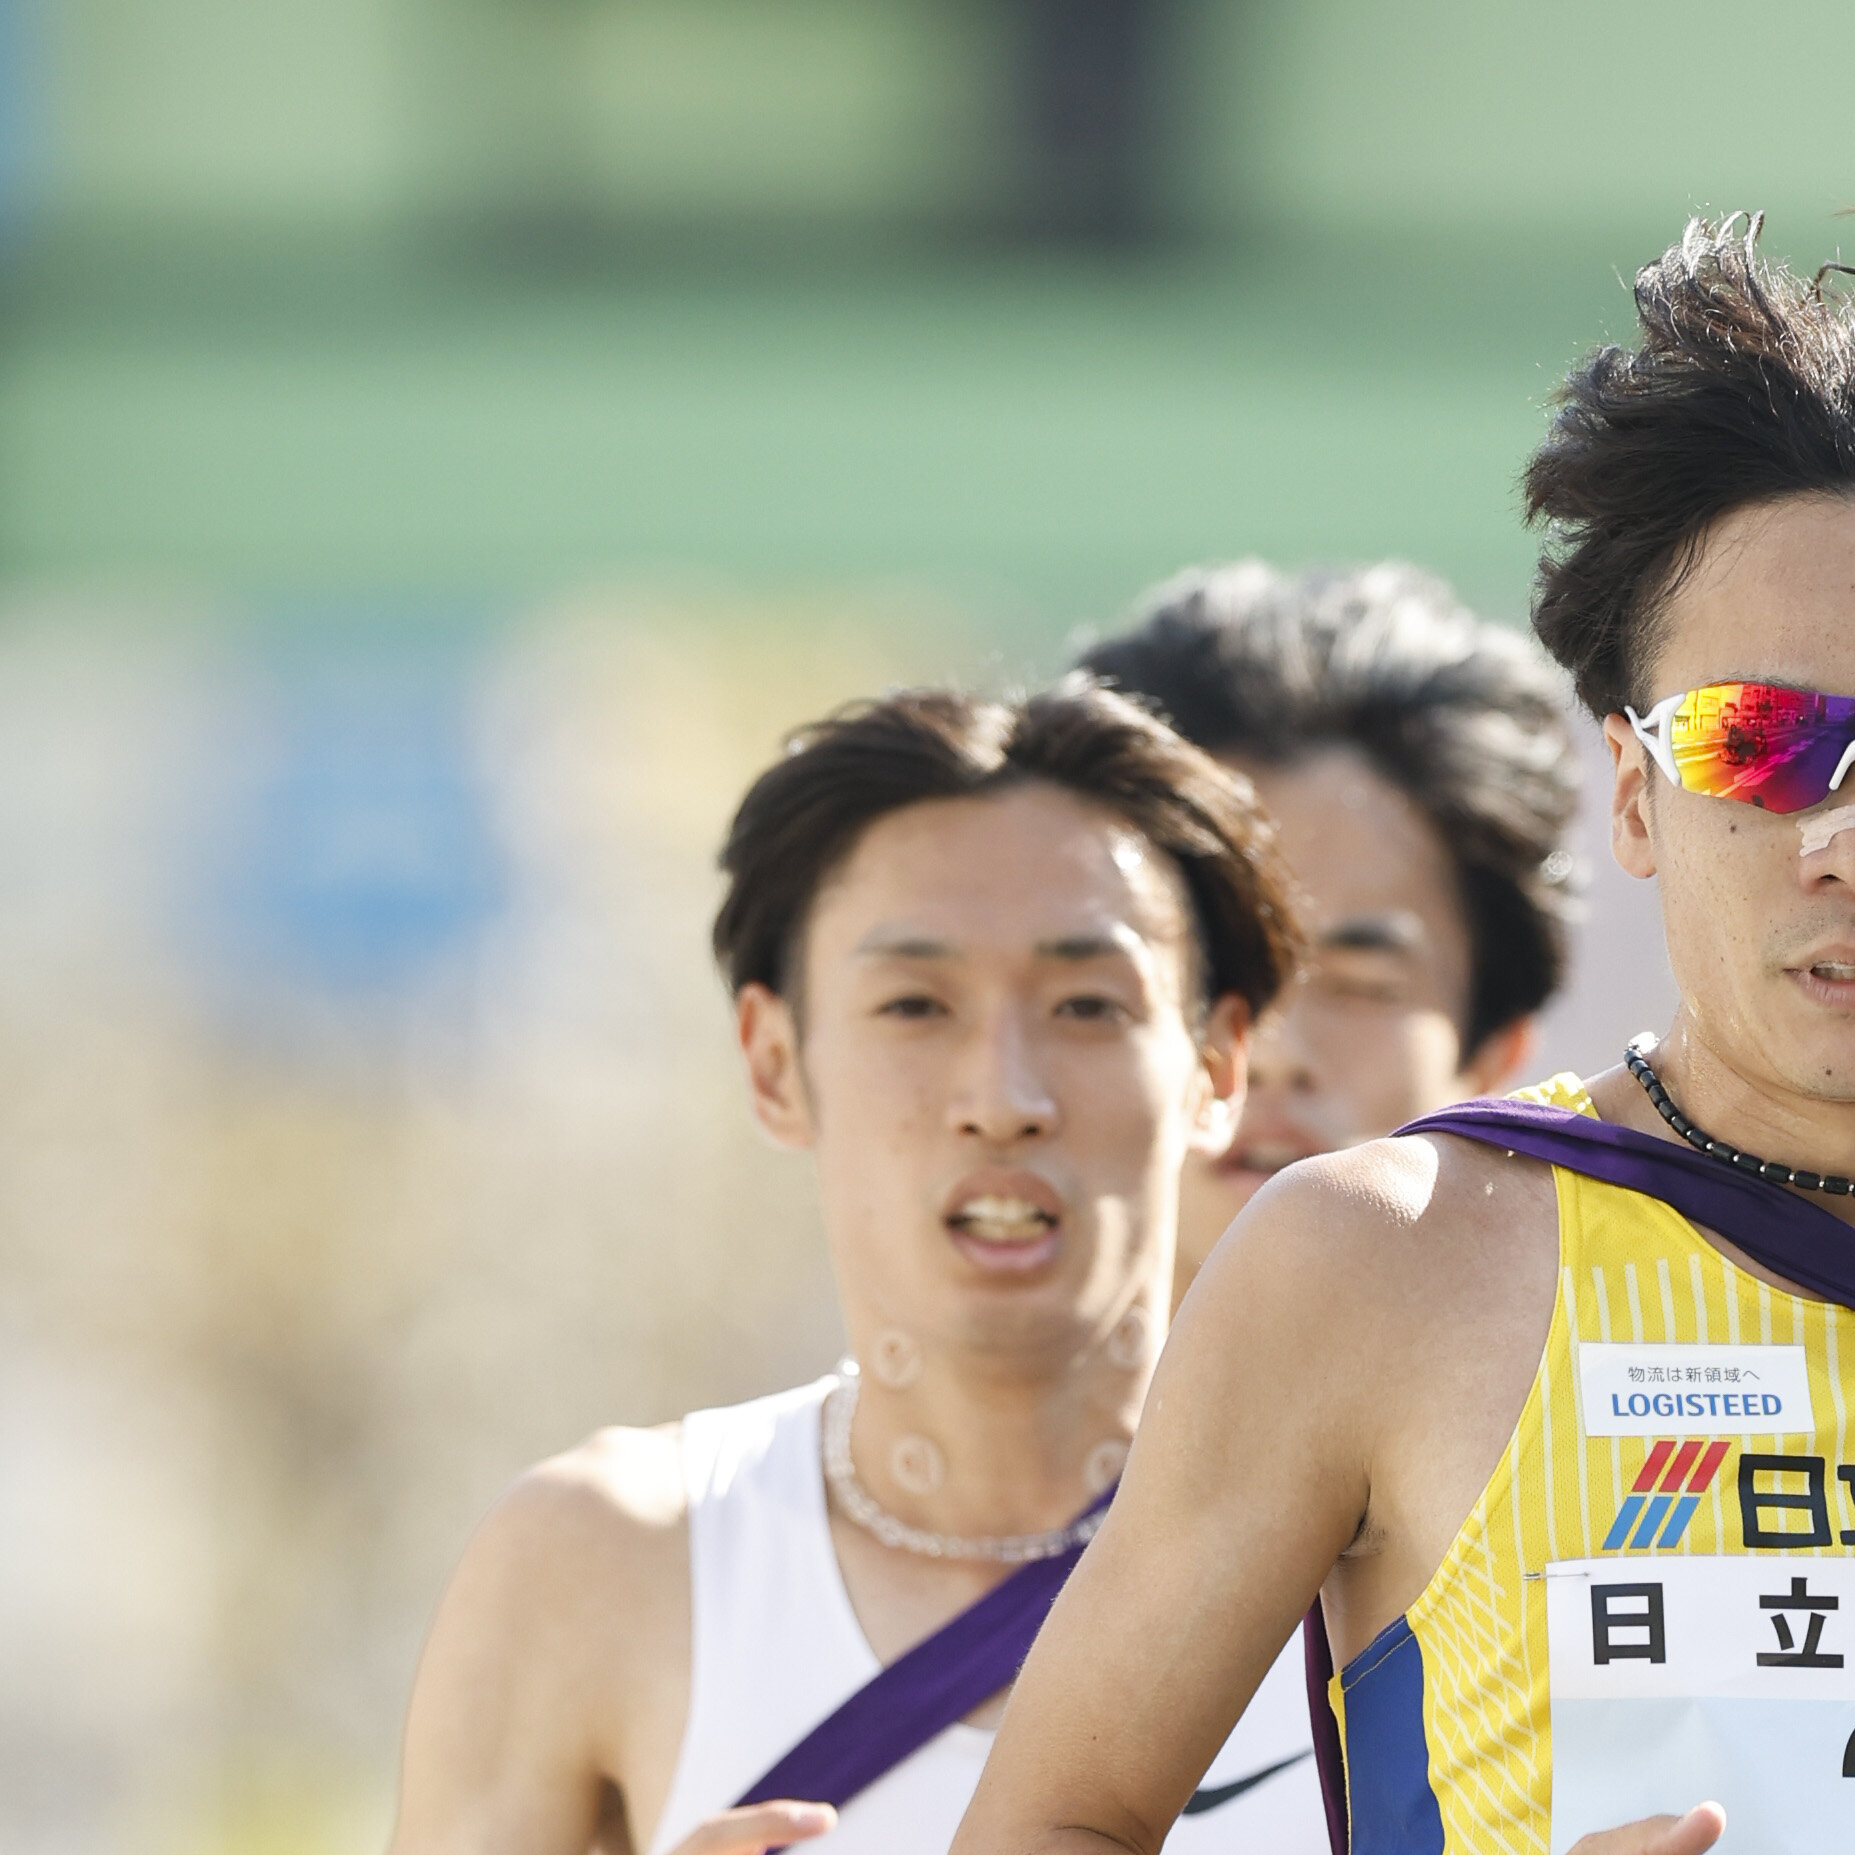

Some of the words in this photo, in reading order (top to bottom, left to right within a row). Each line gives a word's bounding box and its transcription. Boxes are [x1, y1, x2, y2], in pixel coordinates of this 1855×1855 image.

[1627, 1366, 1761, 1383] 物流は新領域へ
[1611, 1393, 1782, 1417] LOGISTEED
